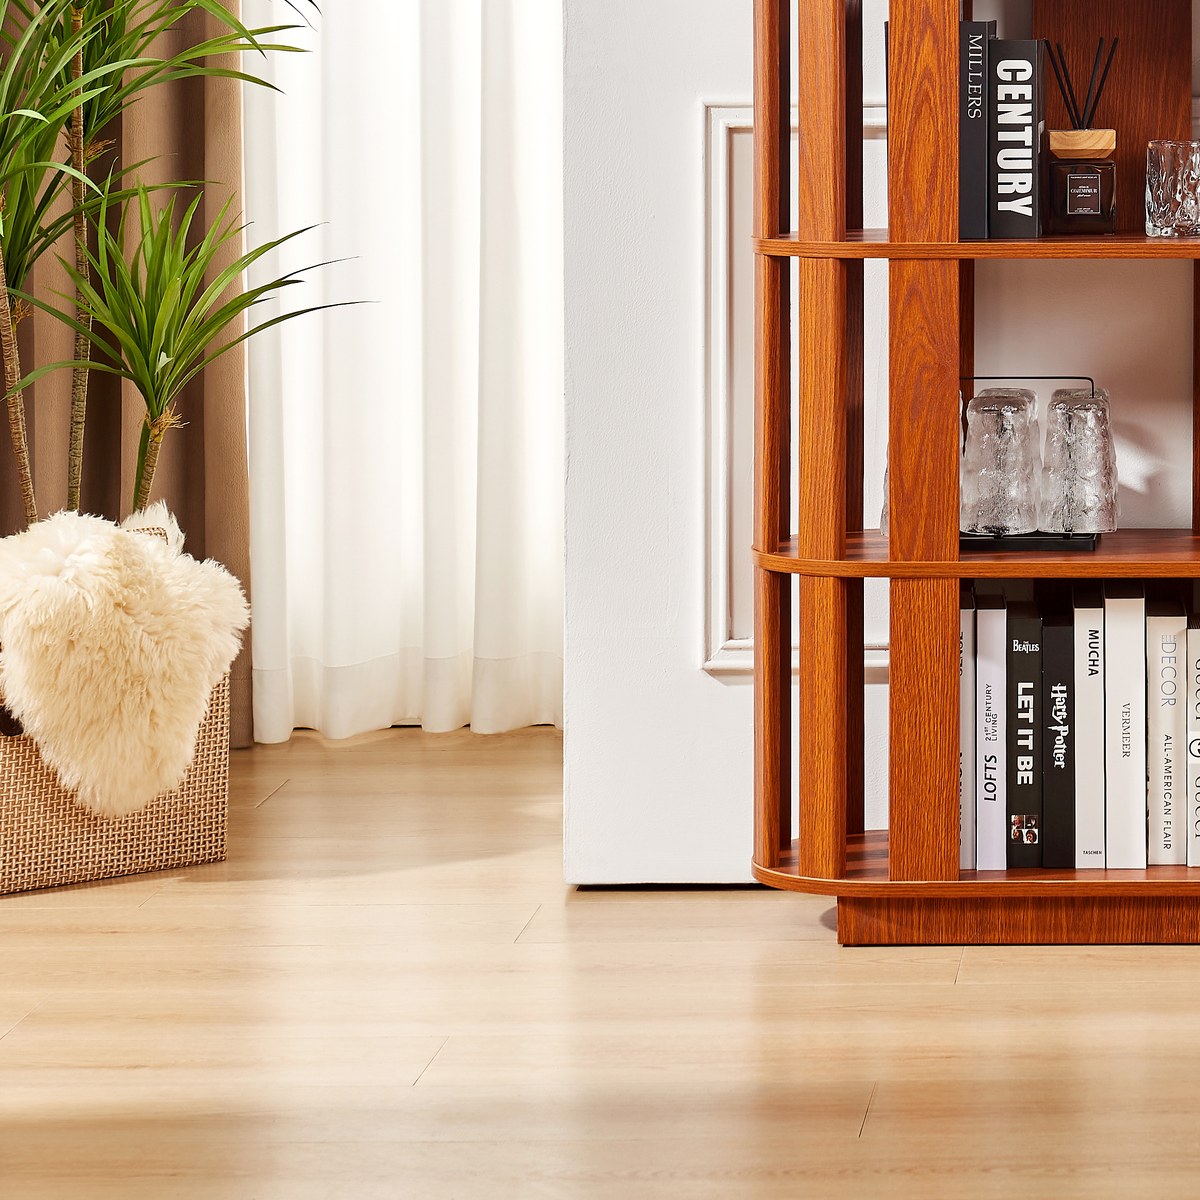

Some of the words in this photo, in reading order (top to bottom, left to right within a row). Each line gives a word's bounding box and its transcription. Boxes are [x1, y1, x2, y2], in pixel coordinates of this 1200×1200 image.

[967, 33, 983, 119] MILLERS
[996, 58, 1033, 217] CENTURY
[1012, 639, 1040, 653] BEATLES
[1088, 629, 1100, 677] MUCHA
[1161, 634, 1177, 643] ELLE
[1160, 642, 1177, 707] DECOR
[1017, 682, 1034, 723] LET
[1050, 683, 1067, 726] Harry
[1017, 728, 1034, 750] IT
[1048, 725, 1070, 769] Potter
[1122, 702, 1131, 758] VERMEER
[983, 754, 997, 802] LOFTS
[1017, 755, 1034, 785] BE
[1163, 734, 1172, 816] ALL-AMERICAN
[1163, 818, 1172, 850] FLAIR
